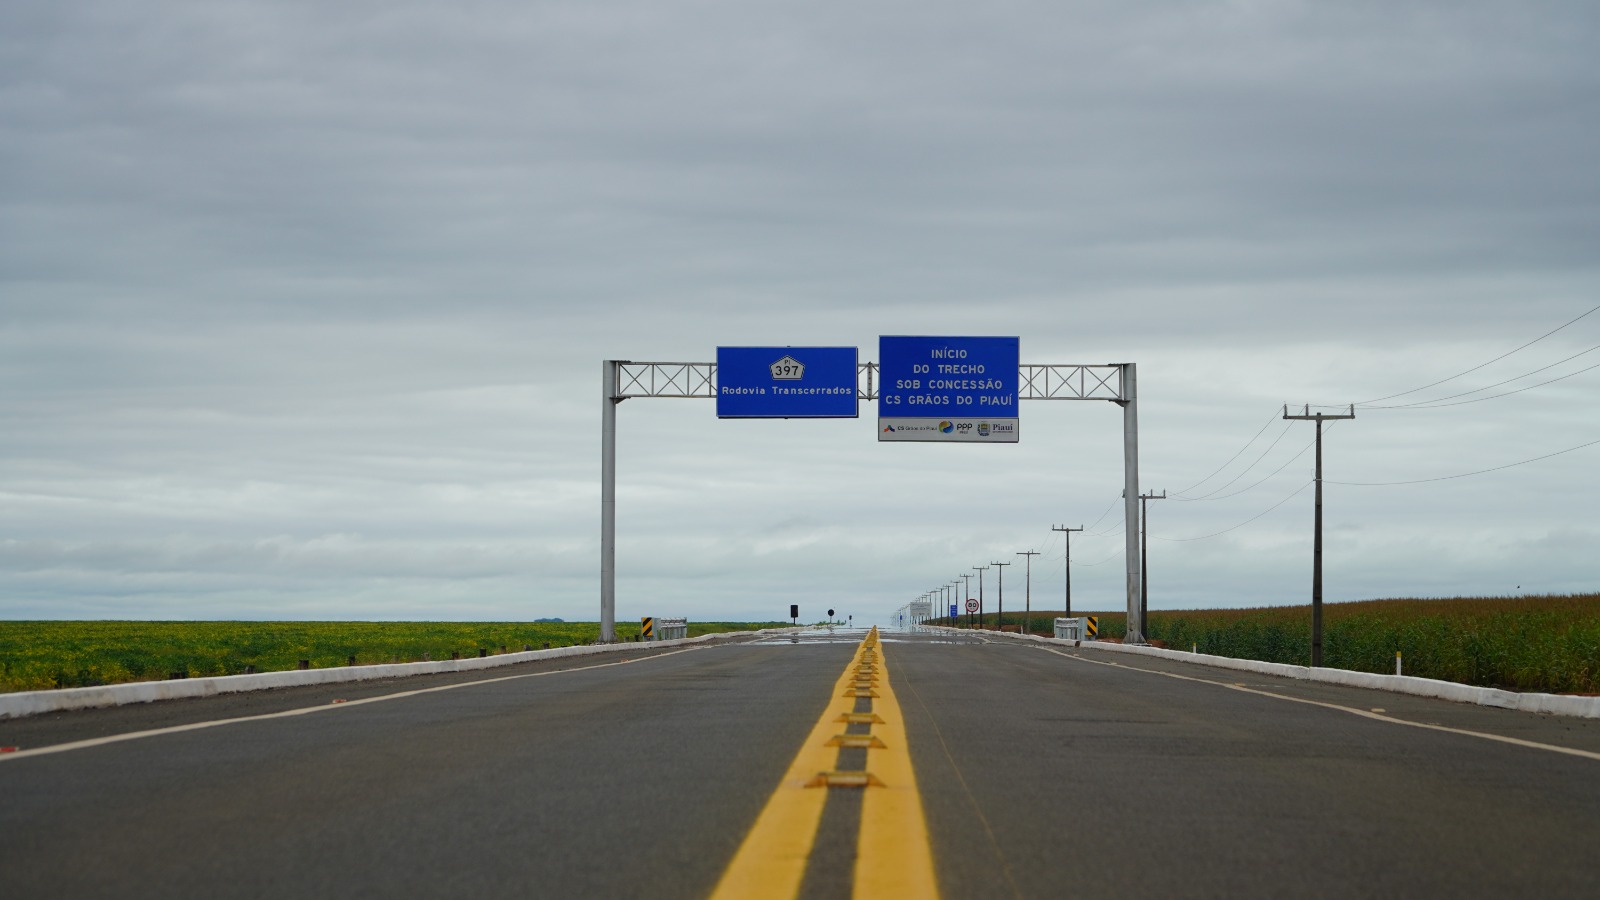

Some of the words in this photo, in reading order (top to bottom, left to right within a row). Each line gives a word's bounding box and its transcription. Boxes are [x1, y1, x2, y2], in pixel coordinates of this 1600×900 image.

[931, 346, 967, 359] INÍCIO
[775, 365, 799, 376] 397
[913, 364, 930, 374] DO
[937, 364, 985, 374] TRECHO
[896, 379, 921, 389] SOB
[928, 378, 1003, 390] CONCESSÃO
[722, 386, 765, 395] Rodovia
[772, 386, 852, 395] Transcerrados
[885, 395, 901, 405] CS
[908, 393, 950, 405] GRÃOS
[956, 395, 973, 405] DO
[980, 393, 1013, 405] PIAUÍ
[992, 423, 1013, 431] Piauí
